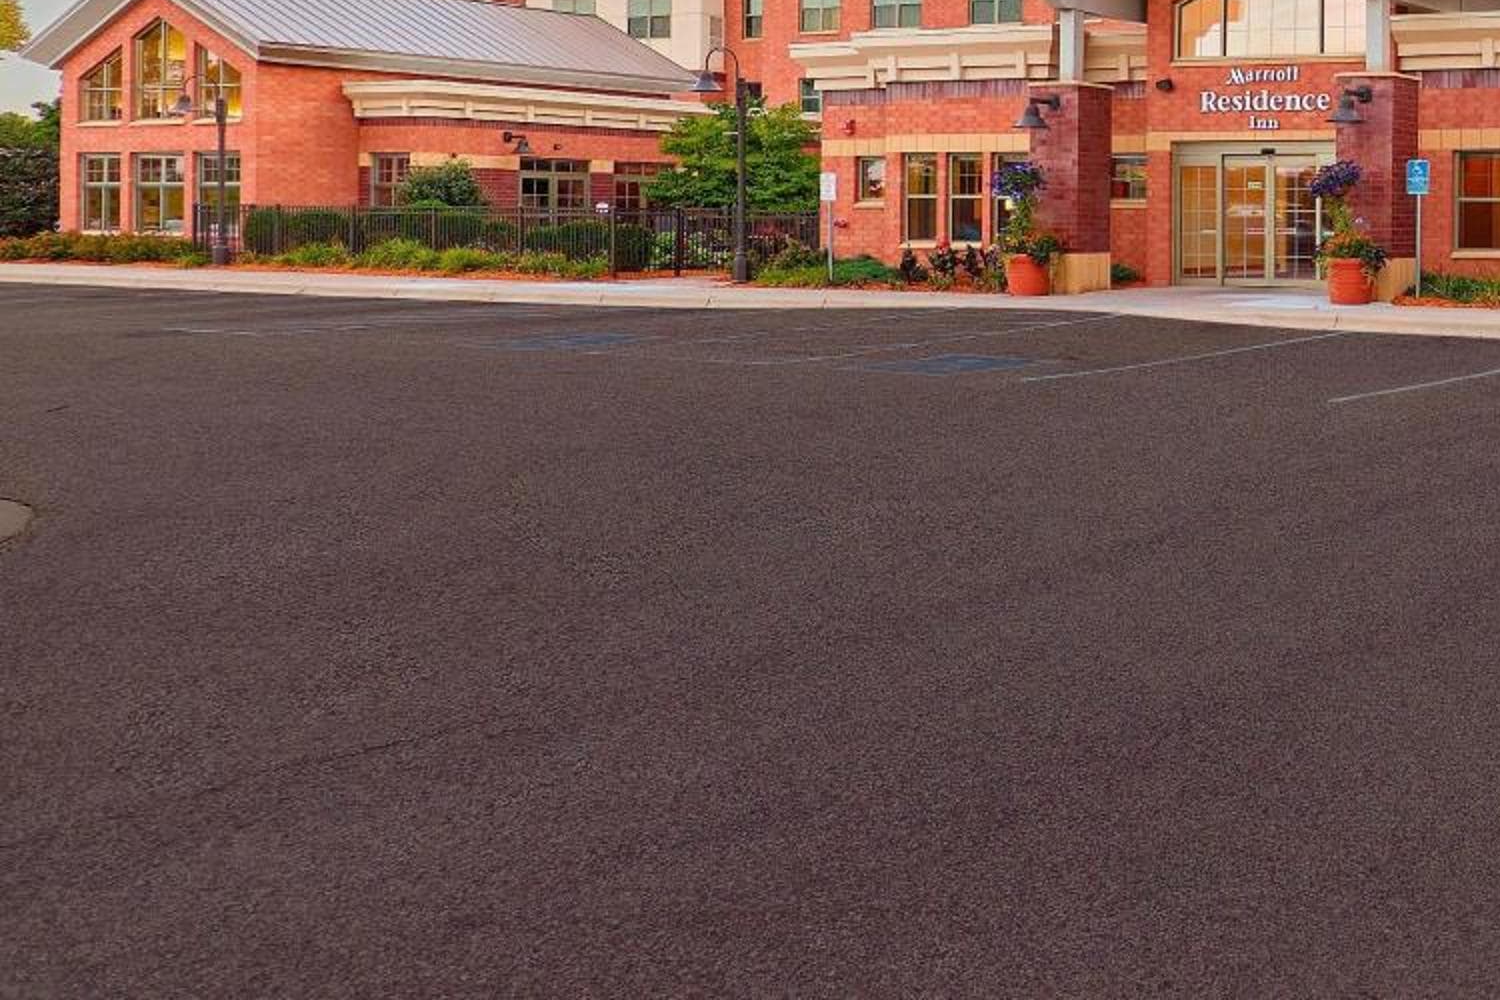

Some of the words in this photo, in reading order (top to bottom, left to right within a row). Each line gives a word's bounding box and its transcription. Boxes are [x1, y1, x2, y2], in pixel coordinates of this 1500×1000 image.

[1225, 66, 1298, 84] Marriott
[1200, 90, 1330, 112] Residence
[1248, 116, 1279, 129] Inn
